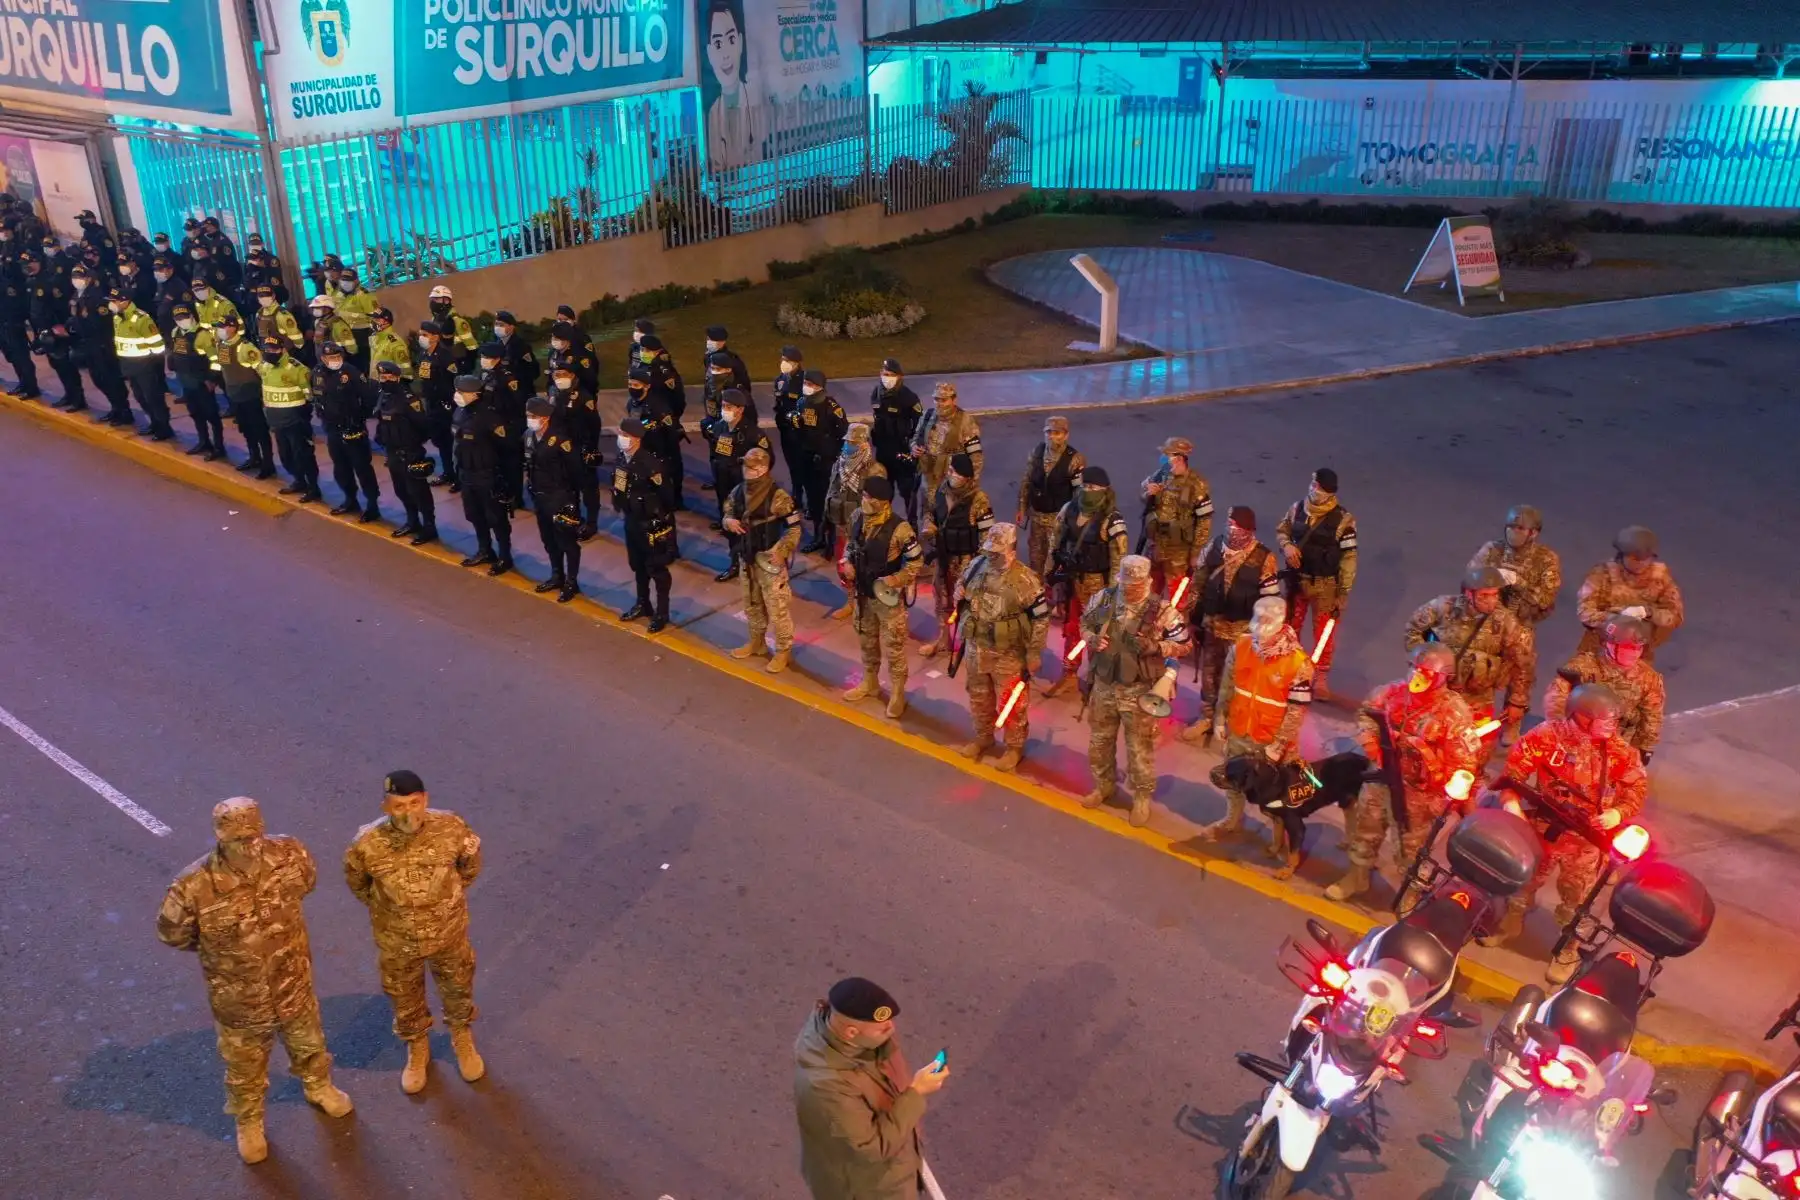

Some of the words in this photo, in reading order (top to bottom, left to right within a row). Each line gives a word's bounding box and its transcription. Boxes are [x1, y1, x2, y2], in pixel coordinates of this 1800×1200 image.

[424, 28, 448, 50] DE
[453, 14, 668, 85] SURQUILLO
[780, 23, 840, 62] CERCA
[290, 75, 363, 94] MUNICIPALIDAD
[365, 74, 378, 86] DE
[291, 87, 382, 119] SURQUILLO
[1456, 251, 1496, 266] SEGURIDAD
[1291, 785, 1310, 800] FAP
